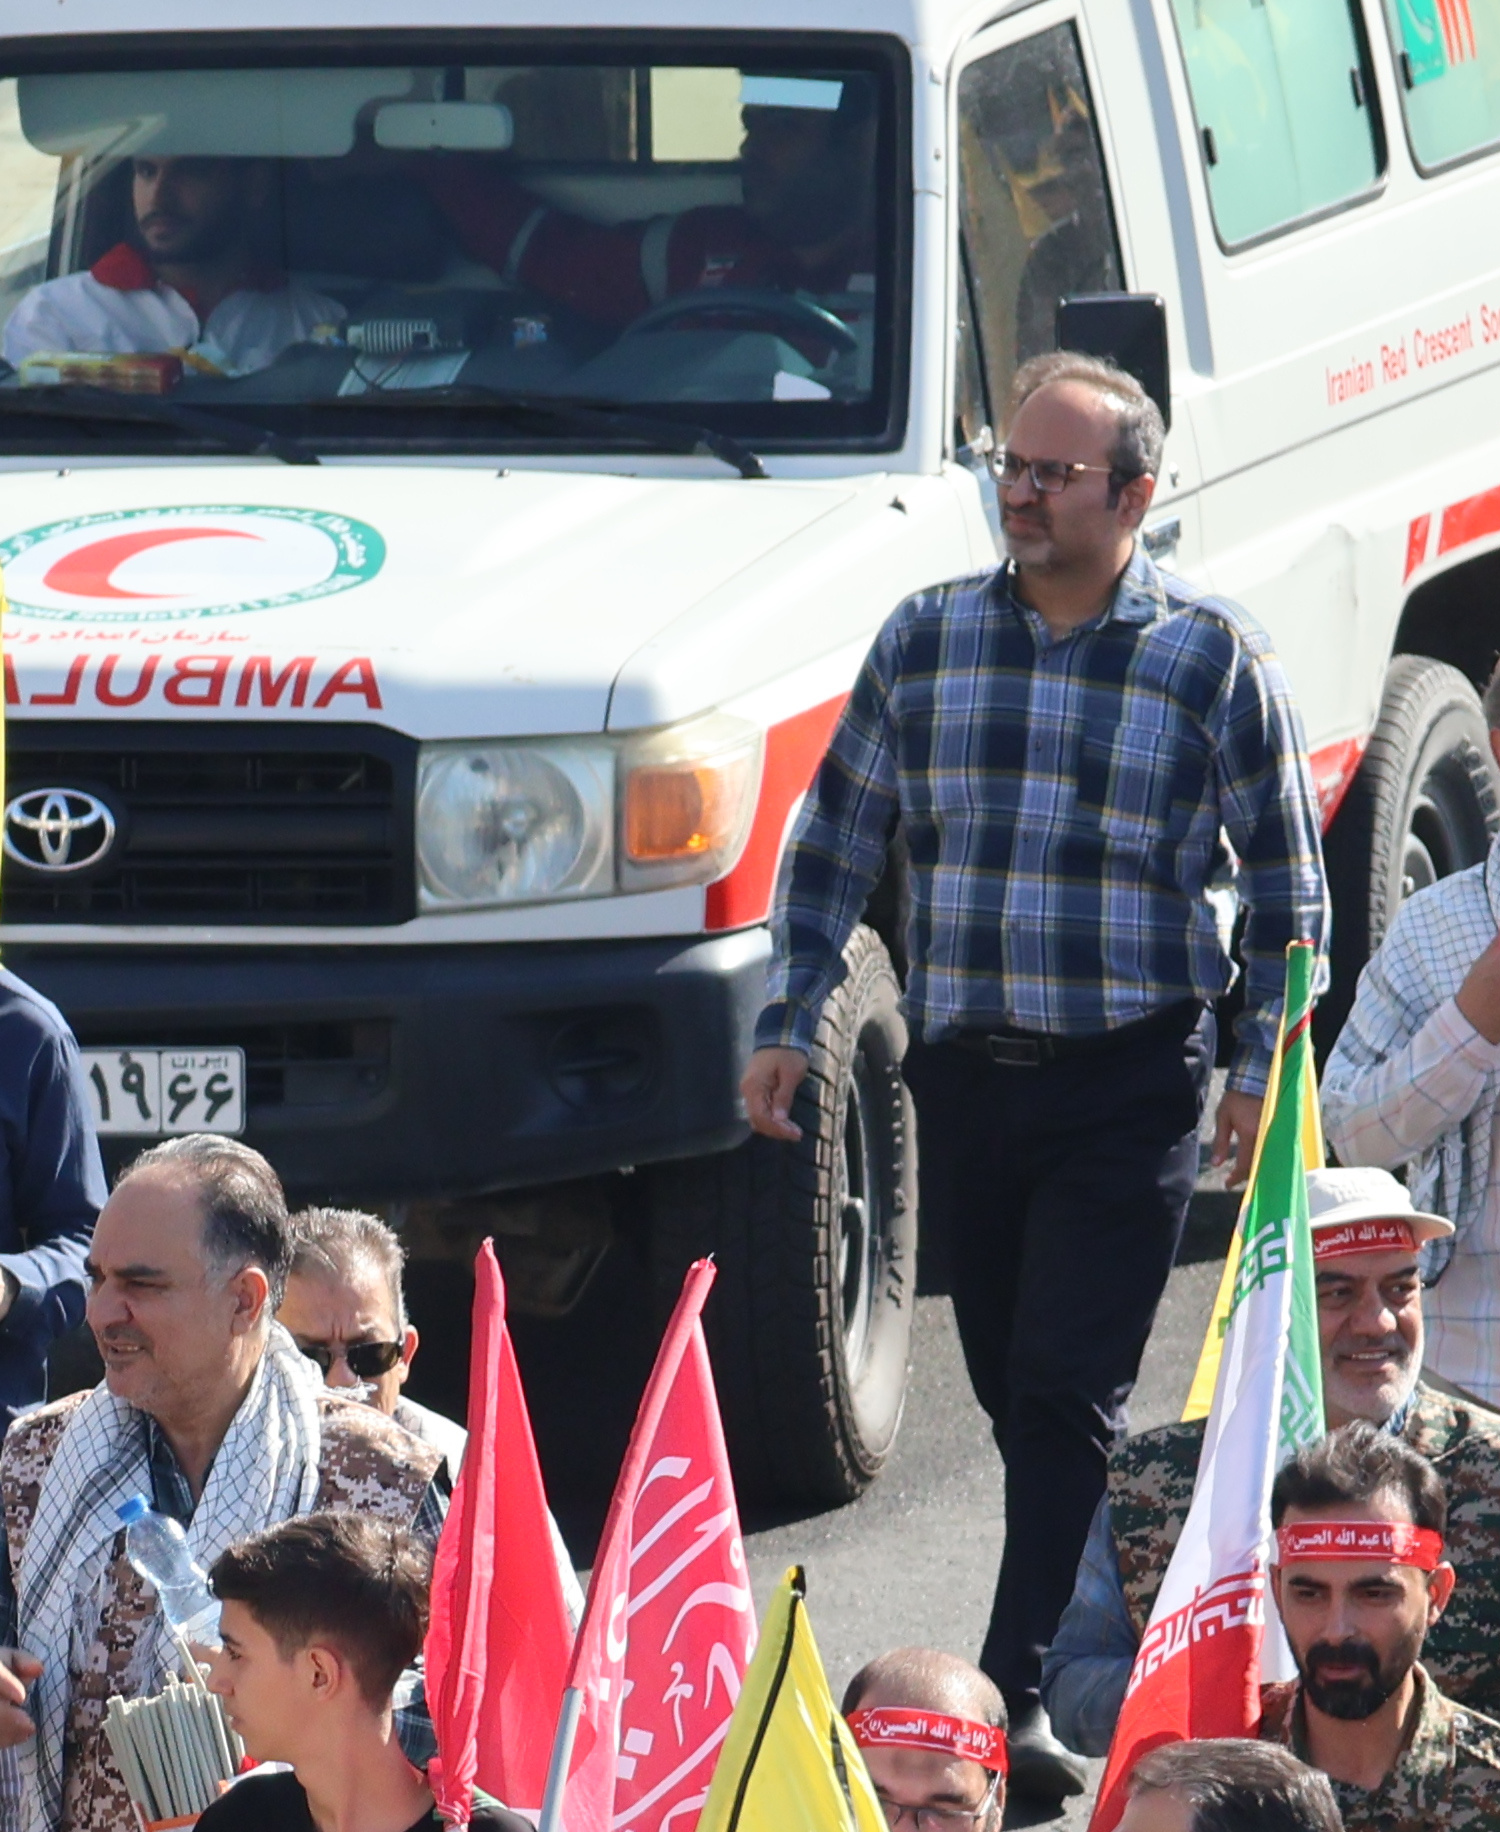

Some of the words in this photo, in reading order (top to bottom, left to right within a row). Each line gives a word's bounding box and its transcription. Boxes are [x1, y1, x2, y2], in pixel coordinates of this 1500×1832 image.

[1326, 356, 1374, 406] Iranian
[1381, 336, 1408, 384] Red
[1413, 310, 1474, 369] Crescent
[89, 1060, 152, 1121] ۱۹
[168, 1072, 234, 1124] ۶۶
[1334, 1526, 1356, 1546] الله
[1358, 1532, 1380, 1549] عبد
[929, 1720, 950, 1739] الله
